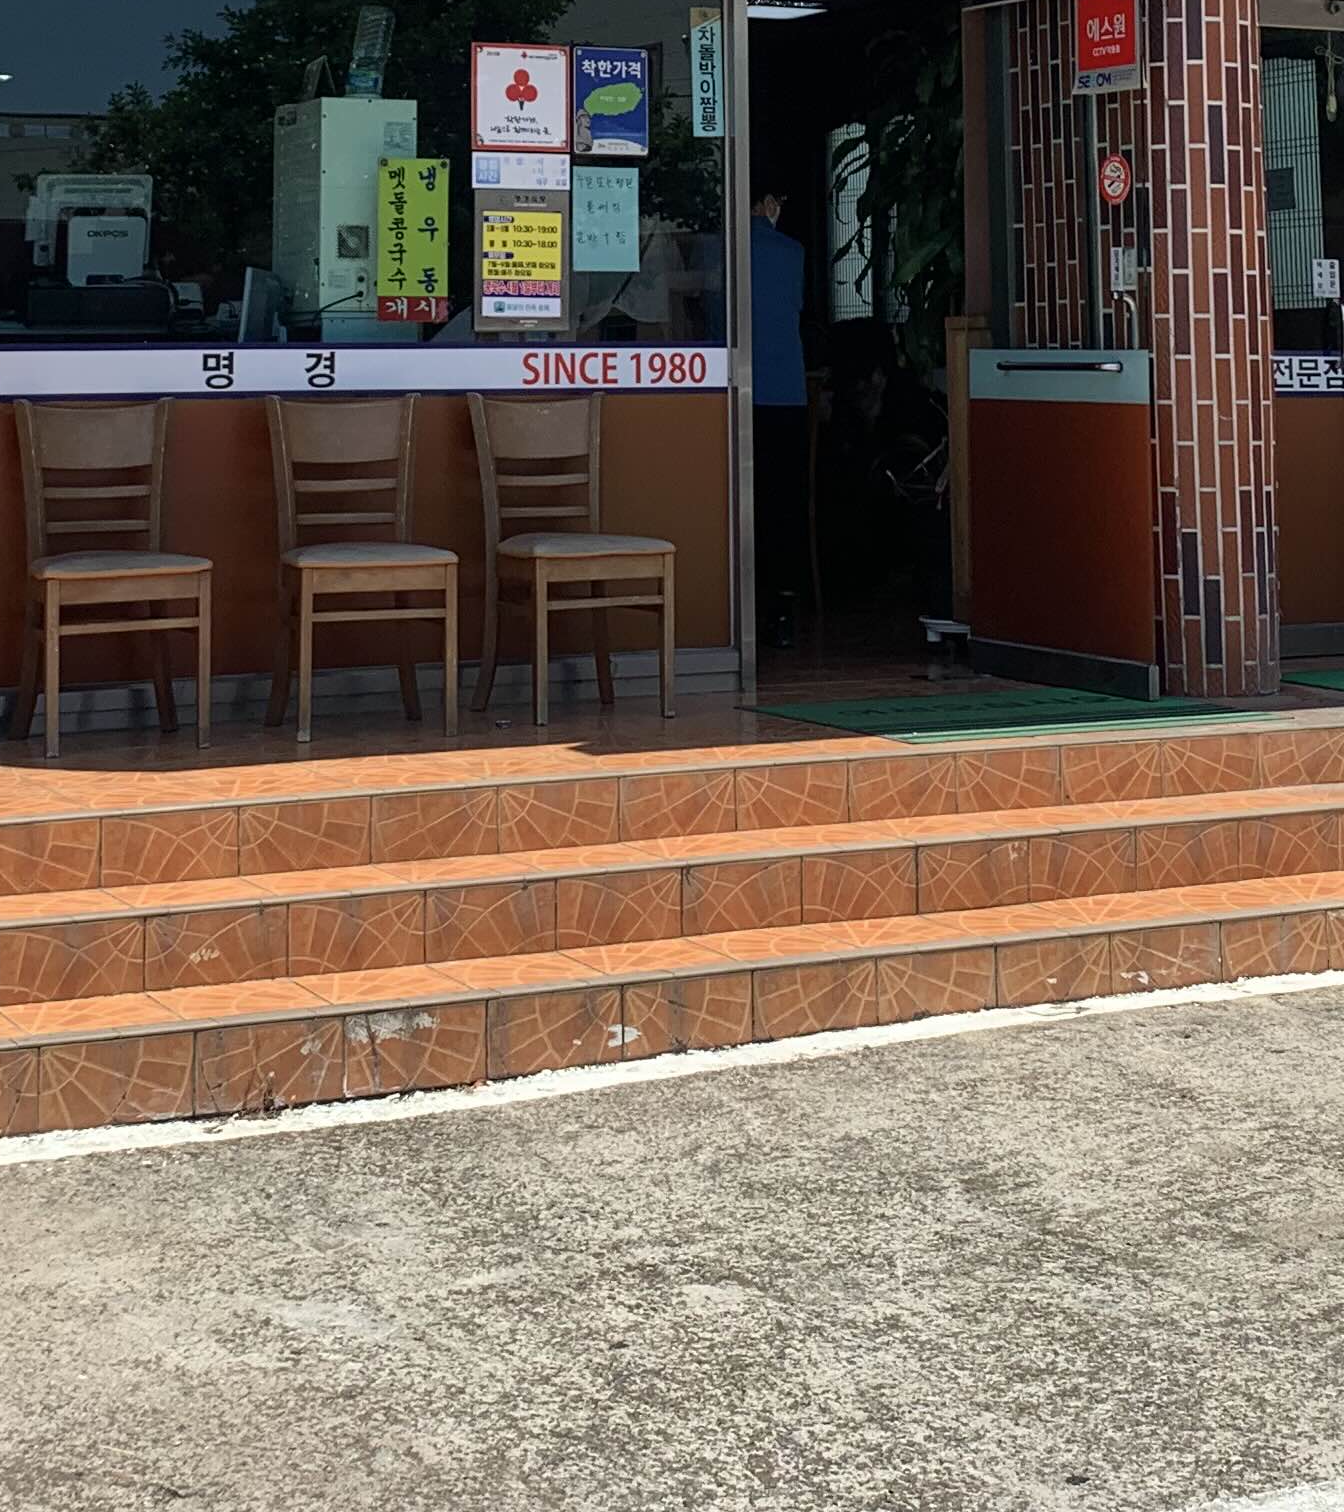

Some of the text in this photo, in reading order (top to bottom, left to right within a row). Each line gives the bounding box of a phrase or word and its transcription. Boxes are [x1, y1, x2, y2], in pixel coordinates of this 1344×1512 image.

[1086, 13, 1127, 42] 에스원
[581, 59, 642, 79] 착한가격
[698, 26, 718, 132] 차돌박이짬뽕
[417, 165, 439, 294] 냉우동
[385, 296, 437, 320] 개시
[522, 352, 707, 385] SINCE 1980
